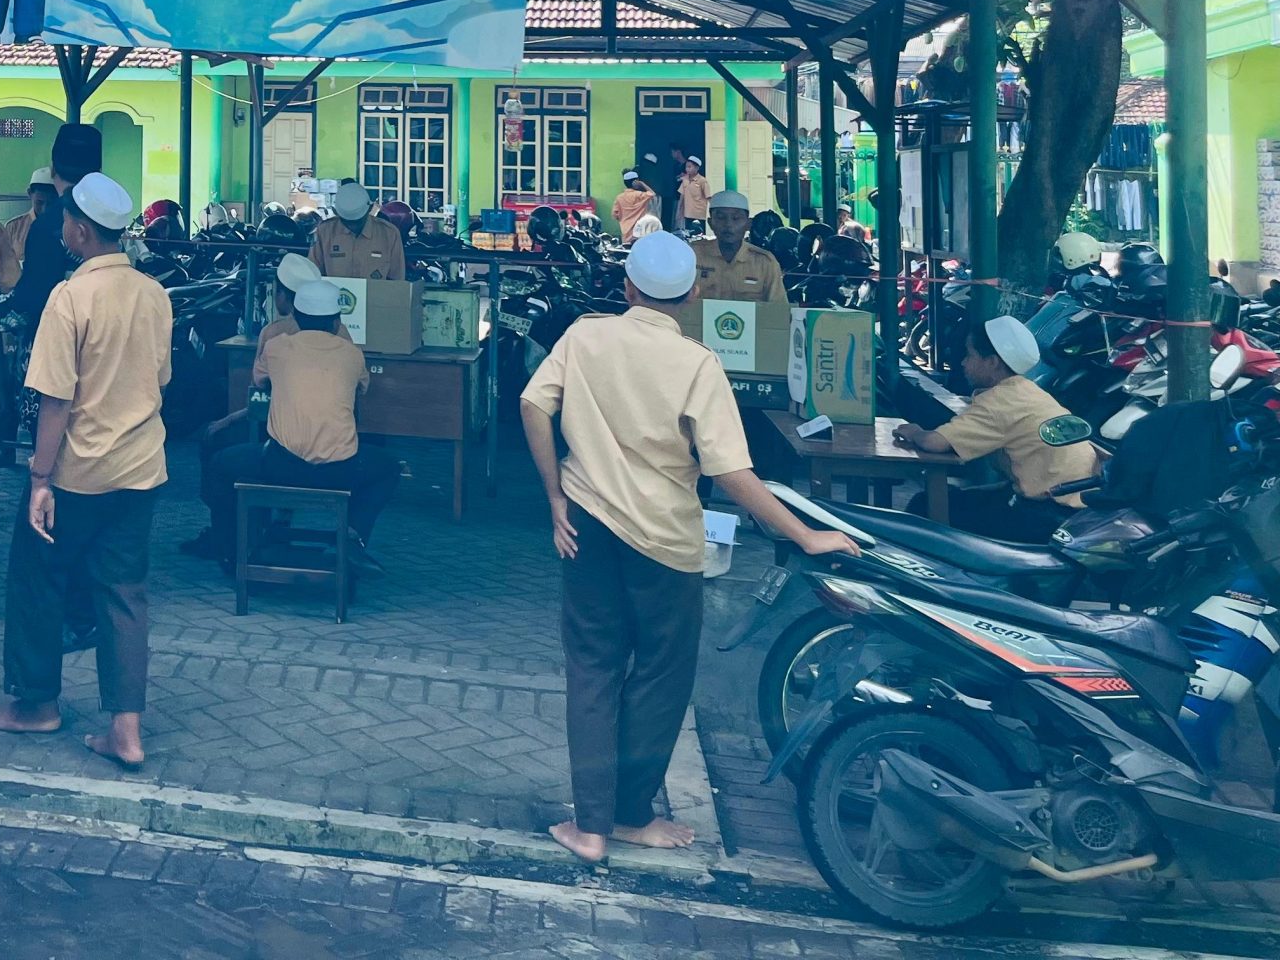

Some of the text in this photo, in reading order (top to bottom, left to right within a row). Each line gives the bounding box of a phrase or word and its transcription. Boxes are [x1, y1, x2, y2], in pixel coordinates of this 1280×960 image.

[371, 366, 384, 374] 03
[815, 337, 835, 394] Santri
[731, 382, 772, 393] AFI 03
